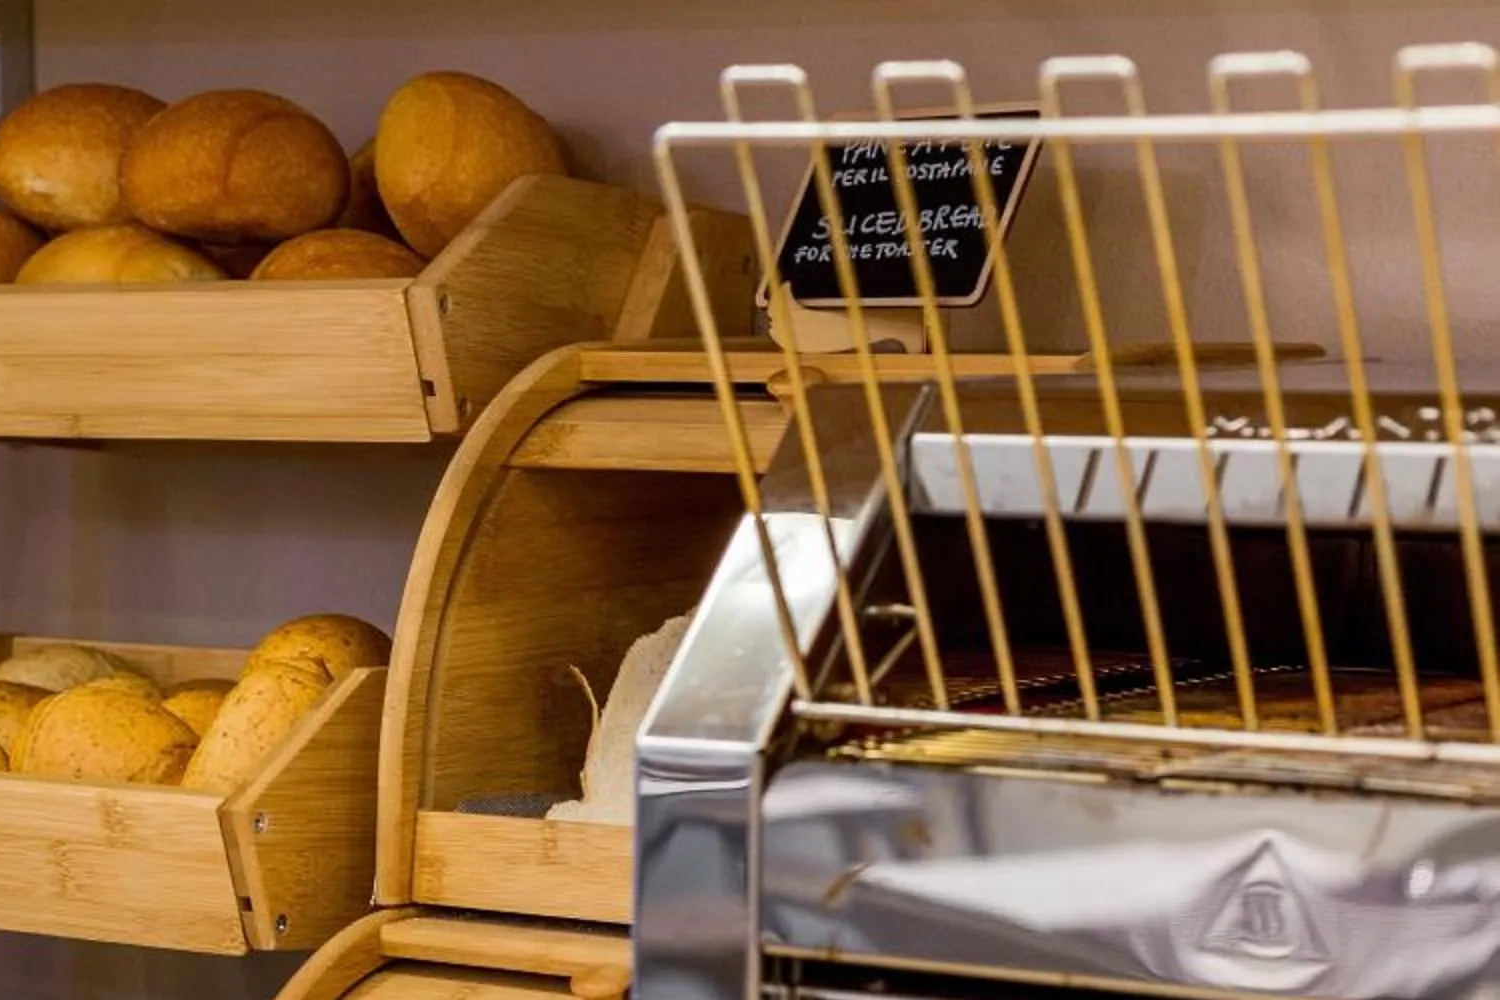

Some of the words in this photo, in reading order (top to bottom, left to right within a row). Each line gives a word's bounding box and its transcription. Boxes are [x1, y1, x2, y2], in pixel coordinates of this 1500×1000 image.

[896, 155, 1005, 181] OSTAPAE
[812, 210, 908, 240] SICE
[920, 204, 995, 233] BREA
[794, 244, 832, 264] FOR
[839, 243, 872, 261] HE
[875, 237, 960, 260] TOAER
